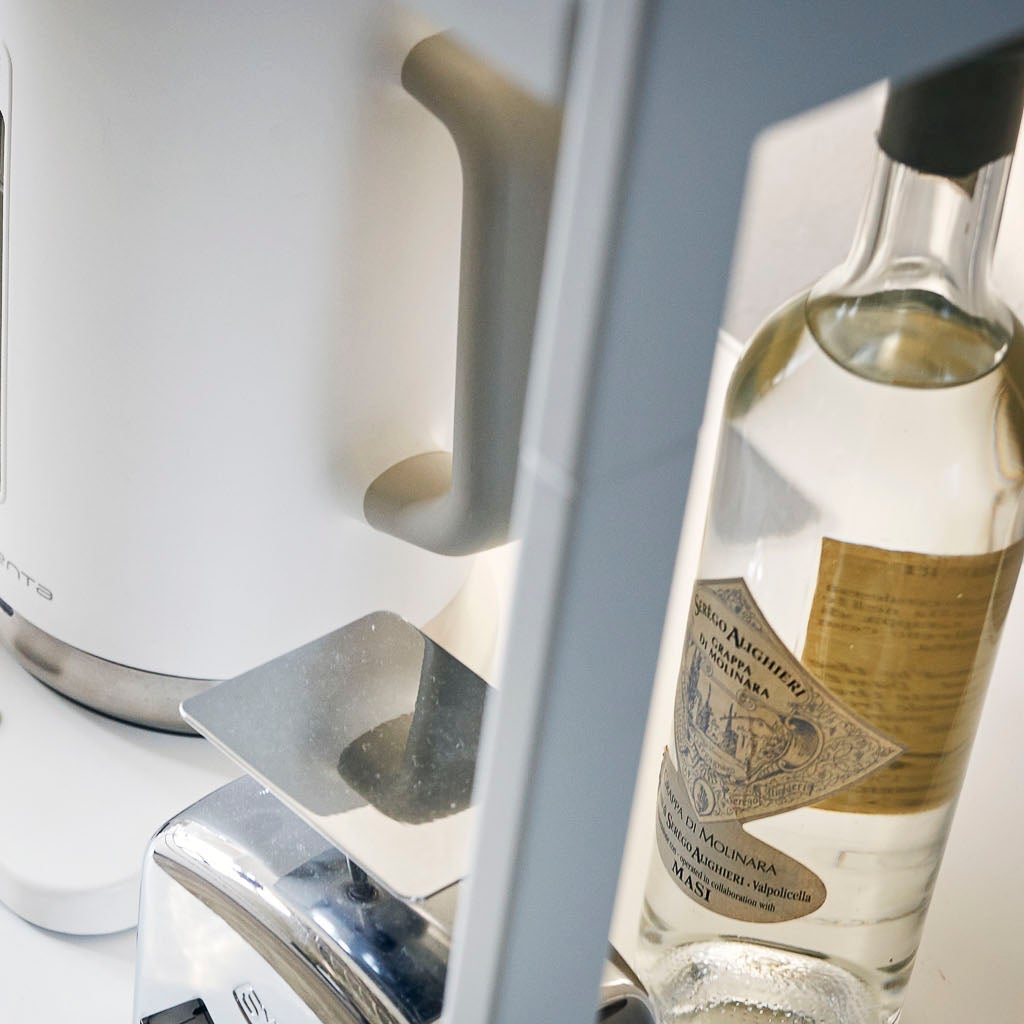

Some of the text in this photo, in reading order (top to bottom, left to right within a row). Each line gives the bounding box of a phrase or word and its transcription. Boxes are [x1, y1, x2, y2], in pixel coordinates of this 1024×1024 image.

[699, 632, 769, 699] DI MOLINARA
[711, 636, 751, 677] GRAPPA
[726, 626, 806, 697] ALIGHIERI
[685, 815, 697, 833] DI
[698, 826, 777, 876] MOLINARA
[671, 859, 712, 903] MASI
[679, 854, 776, 913] operated in collaboration with
[691, 847, 745, 887] ALIGHIERI
[752, 879, 813, 904] Valpolicella
